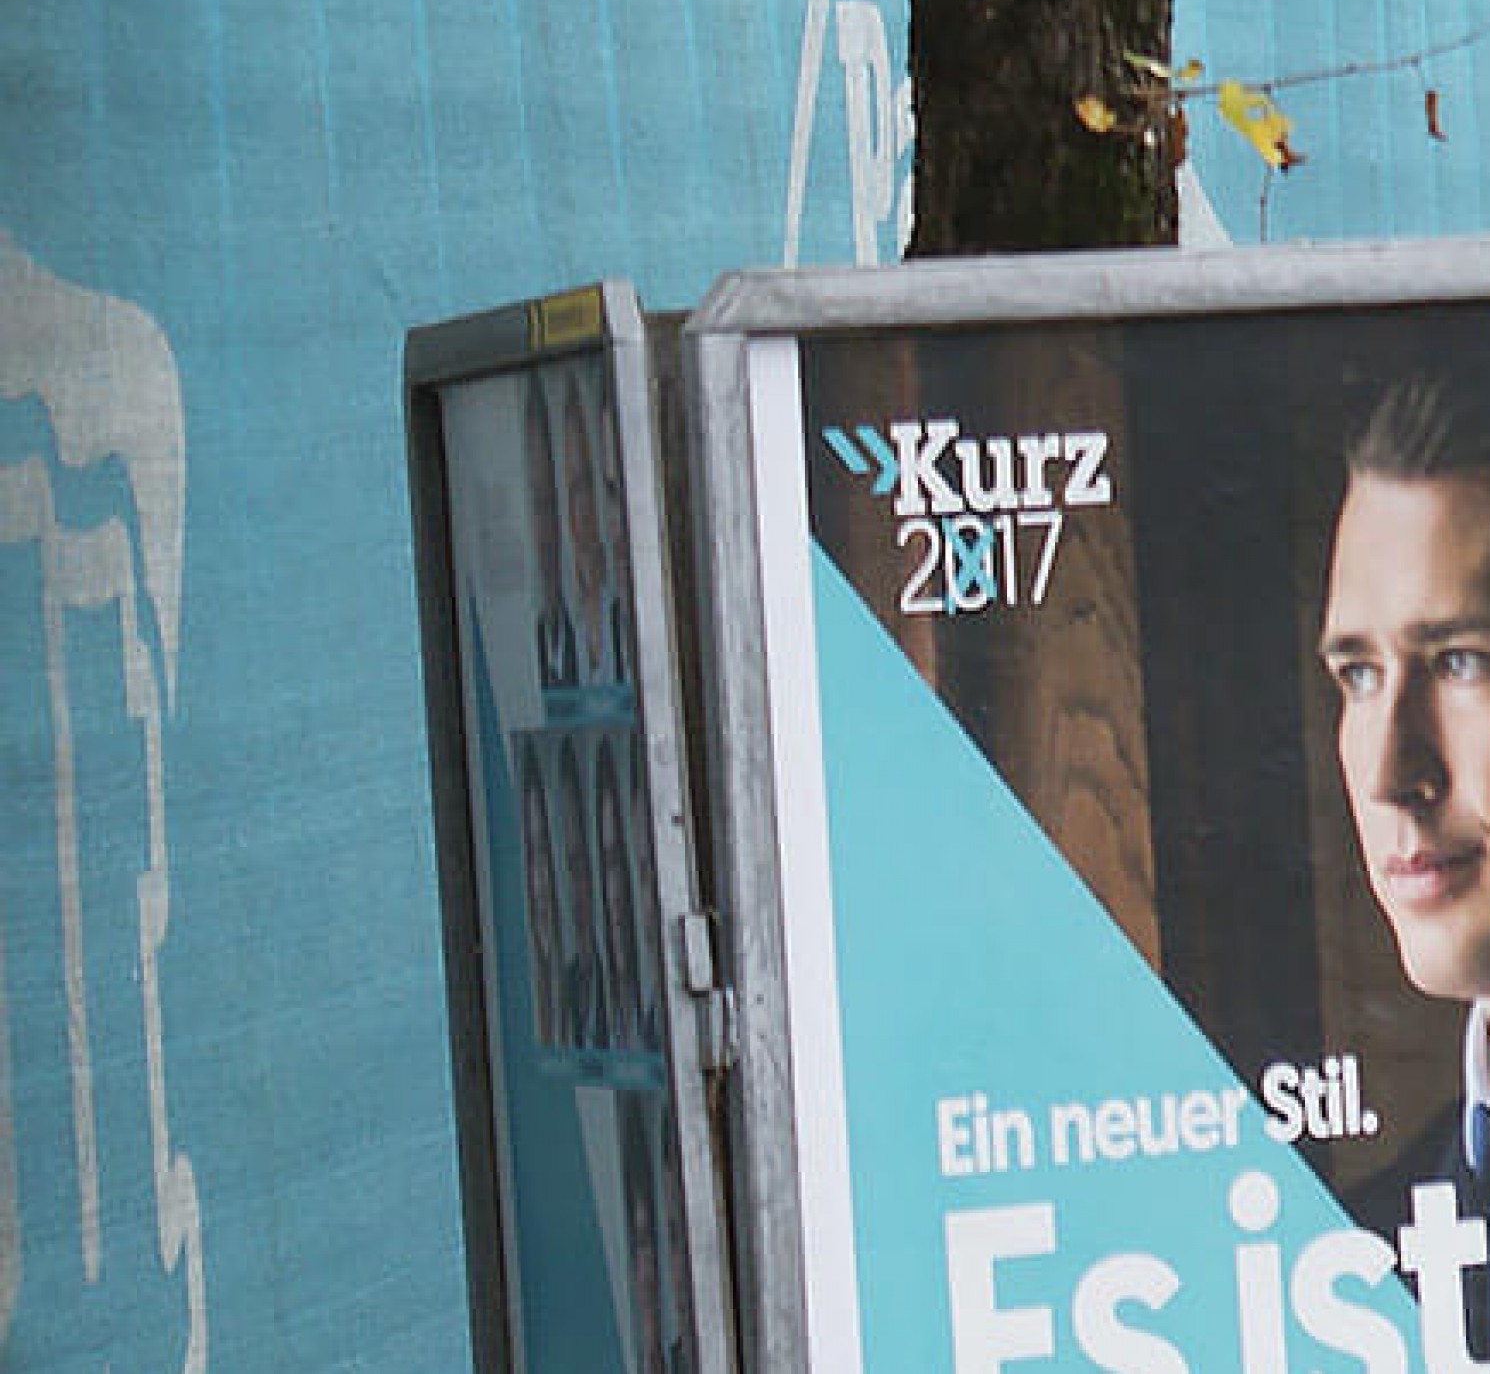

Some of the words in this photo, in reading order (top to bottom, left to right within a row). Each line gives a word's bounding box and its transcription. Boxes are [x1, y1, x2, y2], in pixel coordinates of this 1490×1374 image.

[889, 419, 1111, 516] Kurz
[898, 511, 1062, 615] 2017
[936, 1093, 1035, 1176] Ein
[1050, 1087, 1248, 1164] neuer
[1262, 1055, 1379, 1144] Stil.
[944, 1202, 1190, 1374] Es
